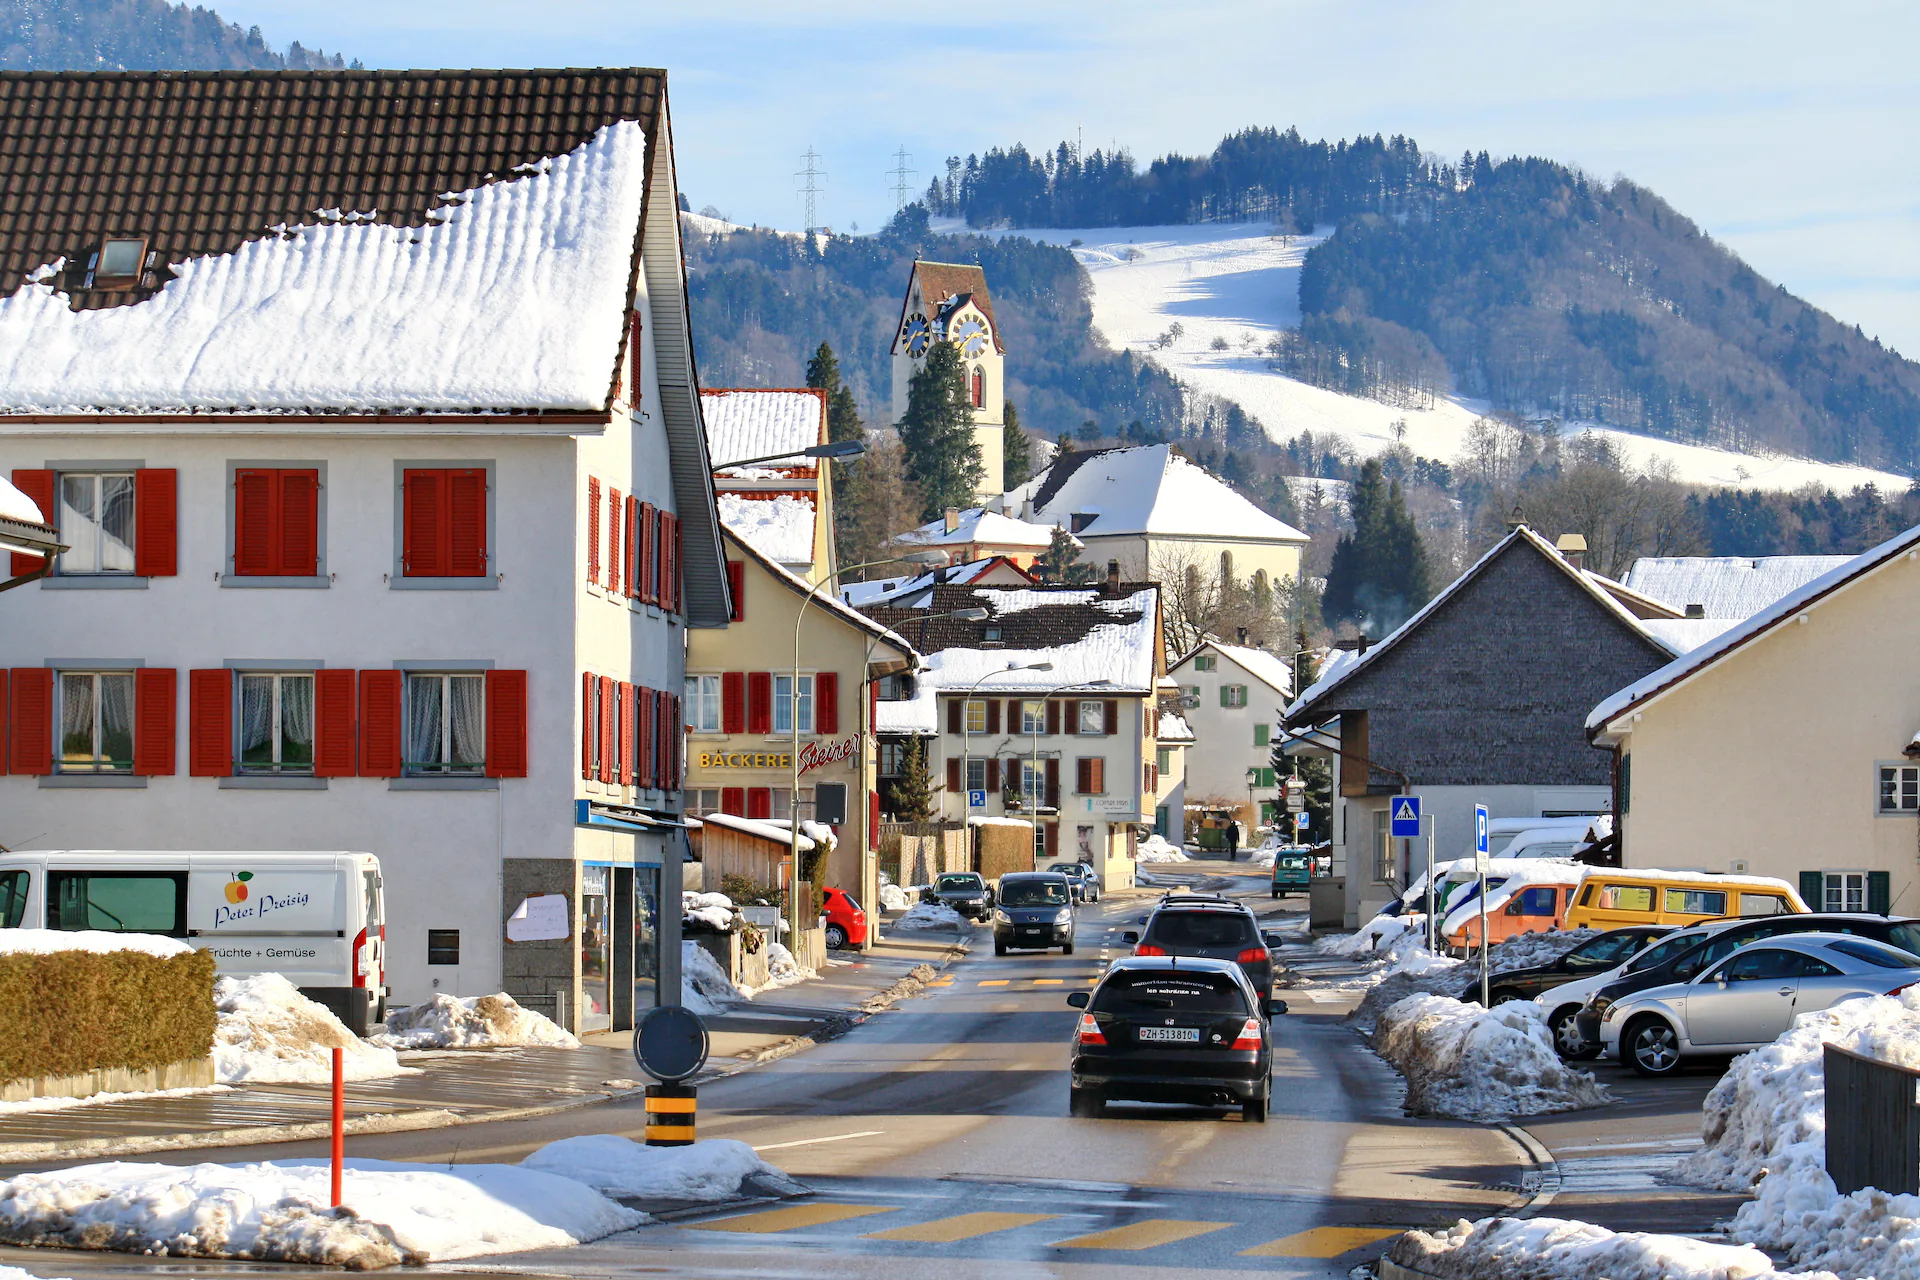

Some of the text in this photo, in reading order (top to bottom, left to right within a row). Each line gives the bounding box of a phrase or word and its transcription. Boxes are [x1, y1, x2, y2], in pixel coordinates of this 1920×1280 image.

[797, 733, 861, 779] Steiner
[972, 792, 980, 804] P
[1478, 814, 1485, 846] P
[215, 892, 309, 929] Peter Preisig
[265, 947, 316, 958] Gemüse
